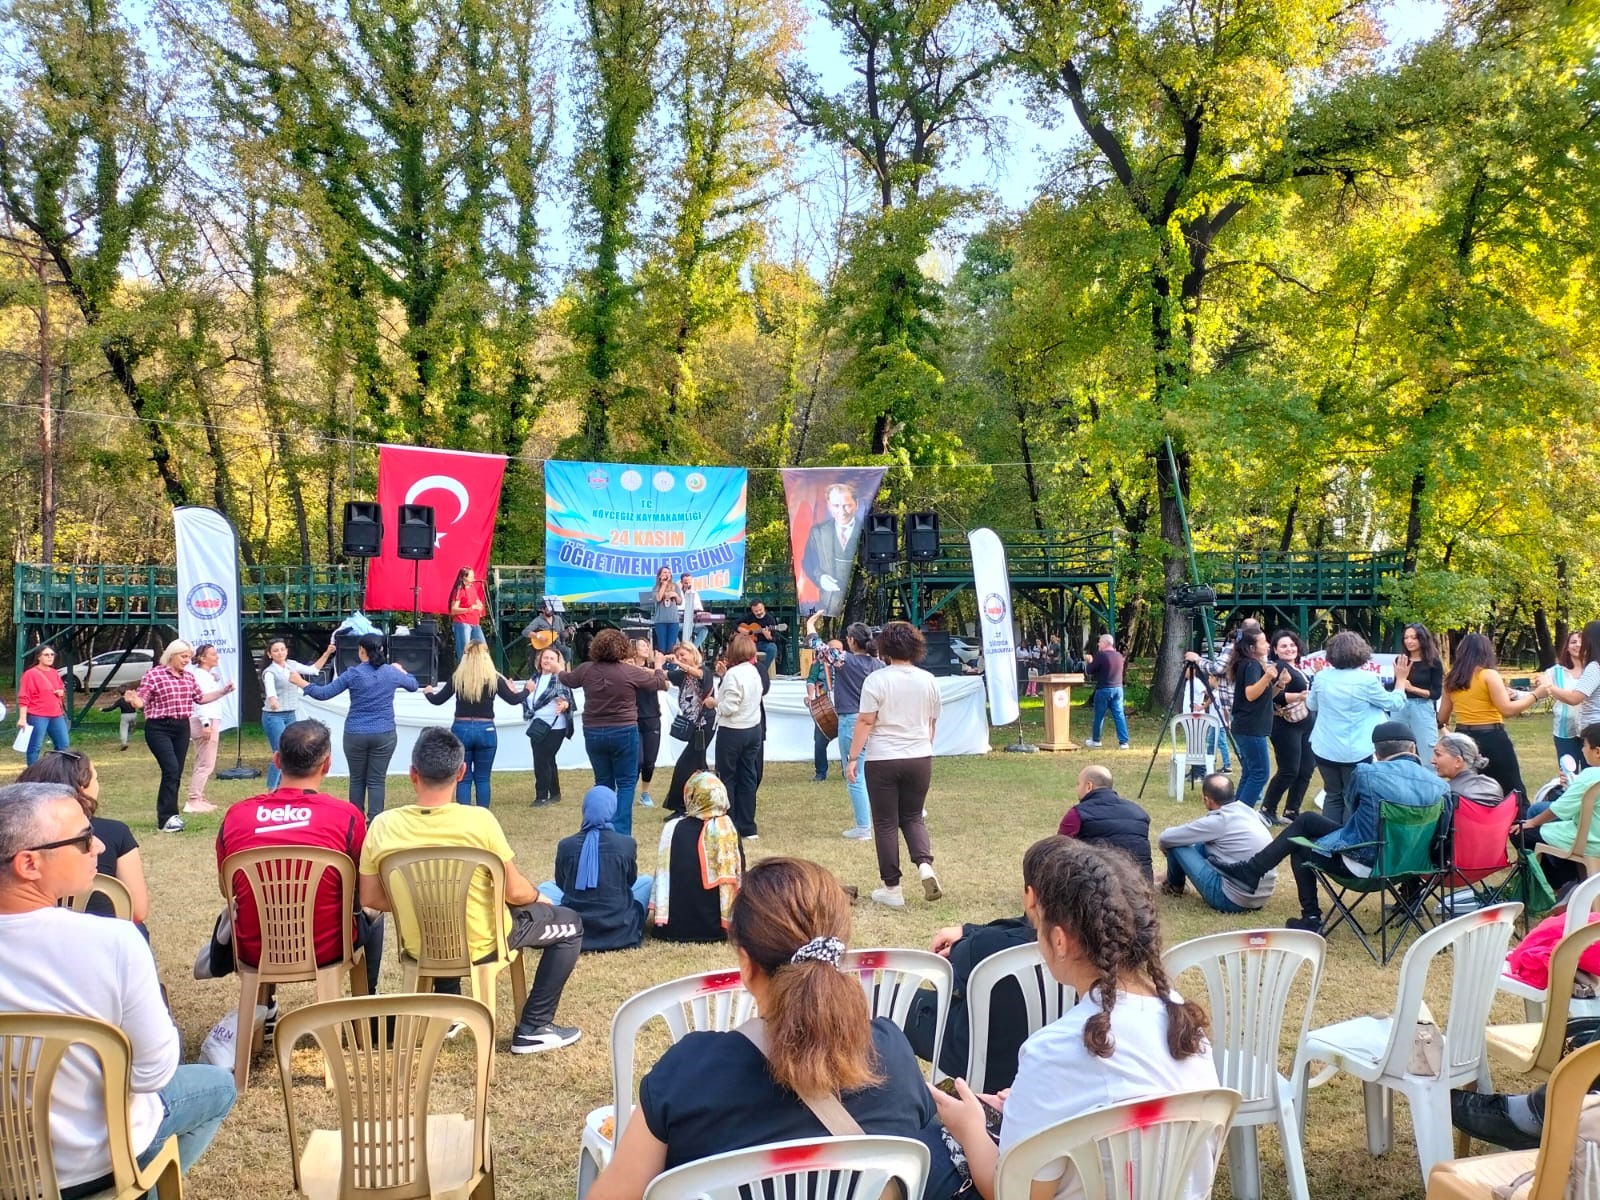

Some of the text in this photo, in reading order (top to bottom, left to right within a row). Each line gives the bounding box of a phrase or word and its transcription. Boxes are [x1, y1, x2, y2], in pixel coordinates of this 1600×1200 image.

[610, 529, 684, 547] 24 KASIM
[559, 540, 734, 576] ÖĞRETMENLER GÜNÜ
[256, 804, 312, 822] beko
